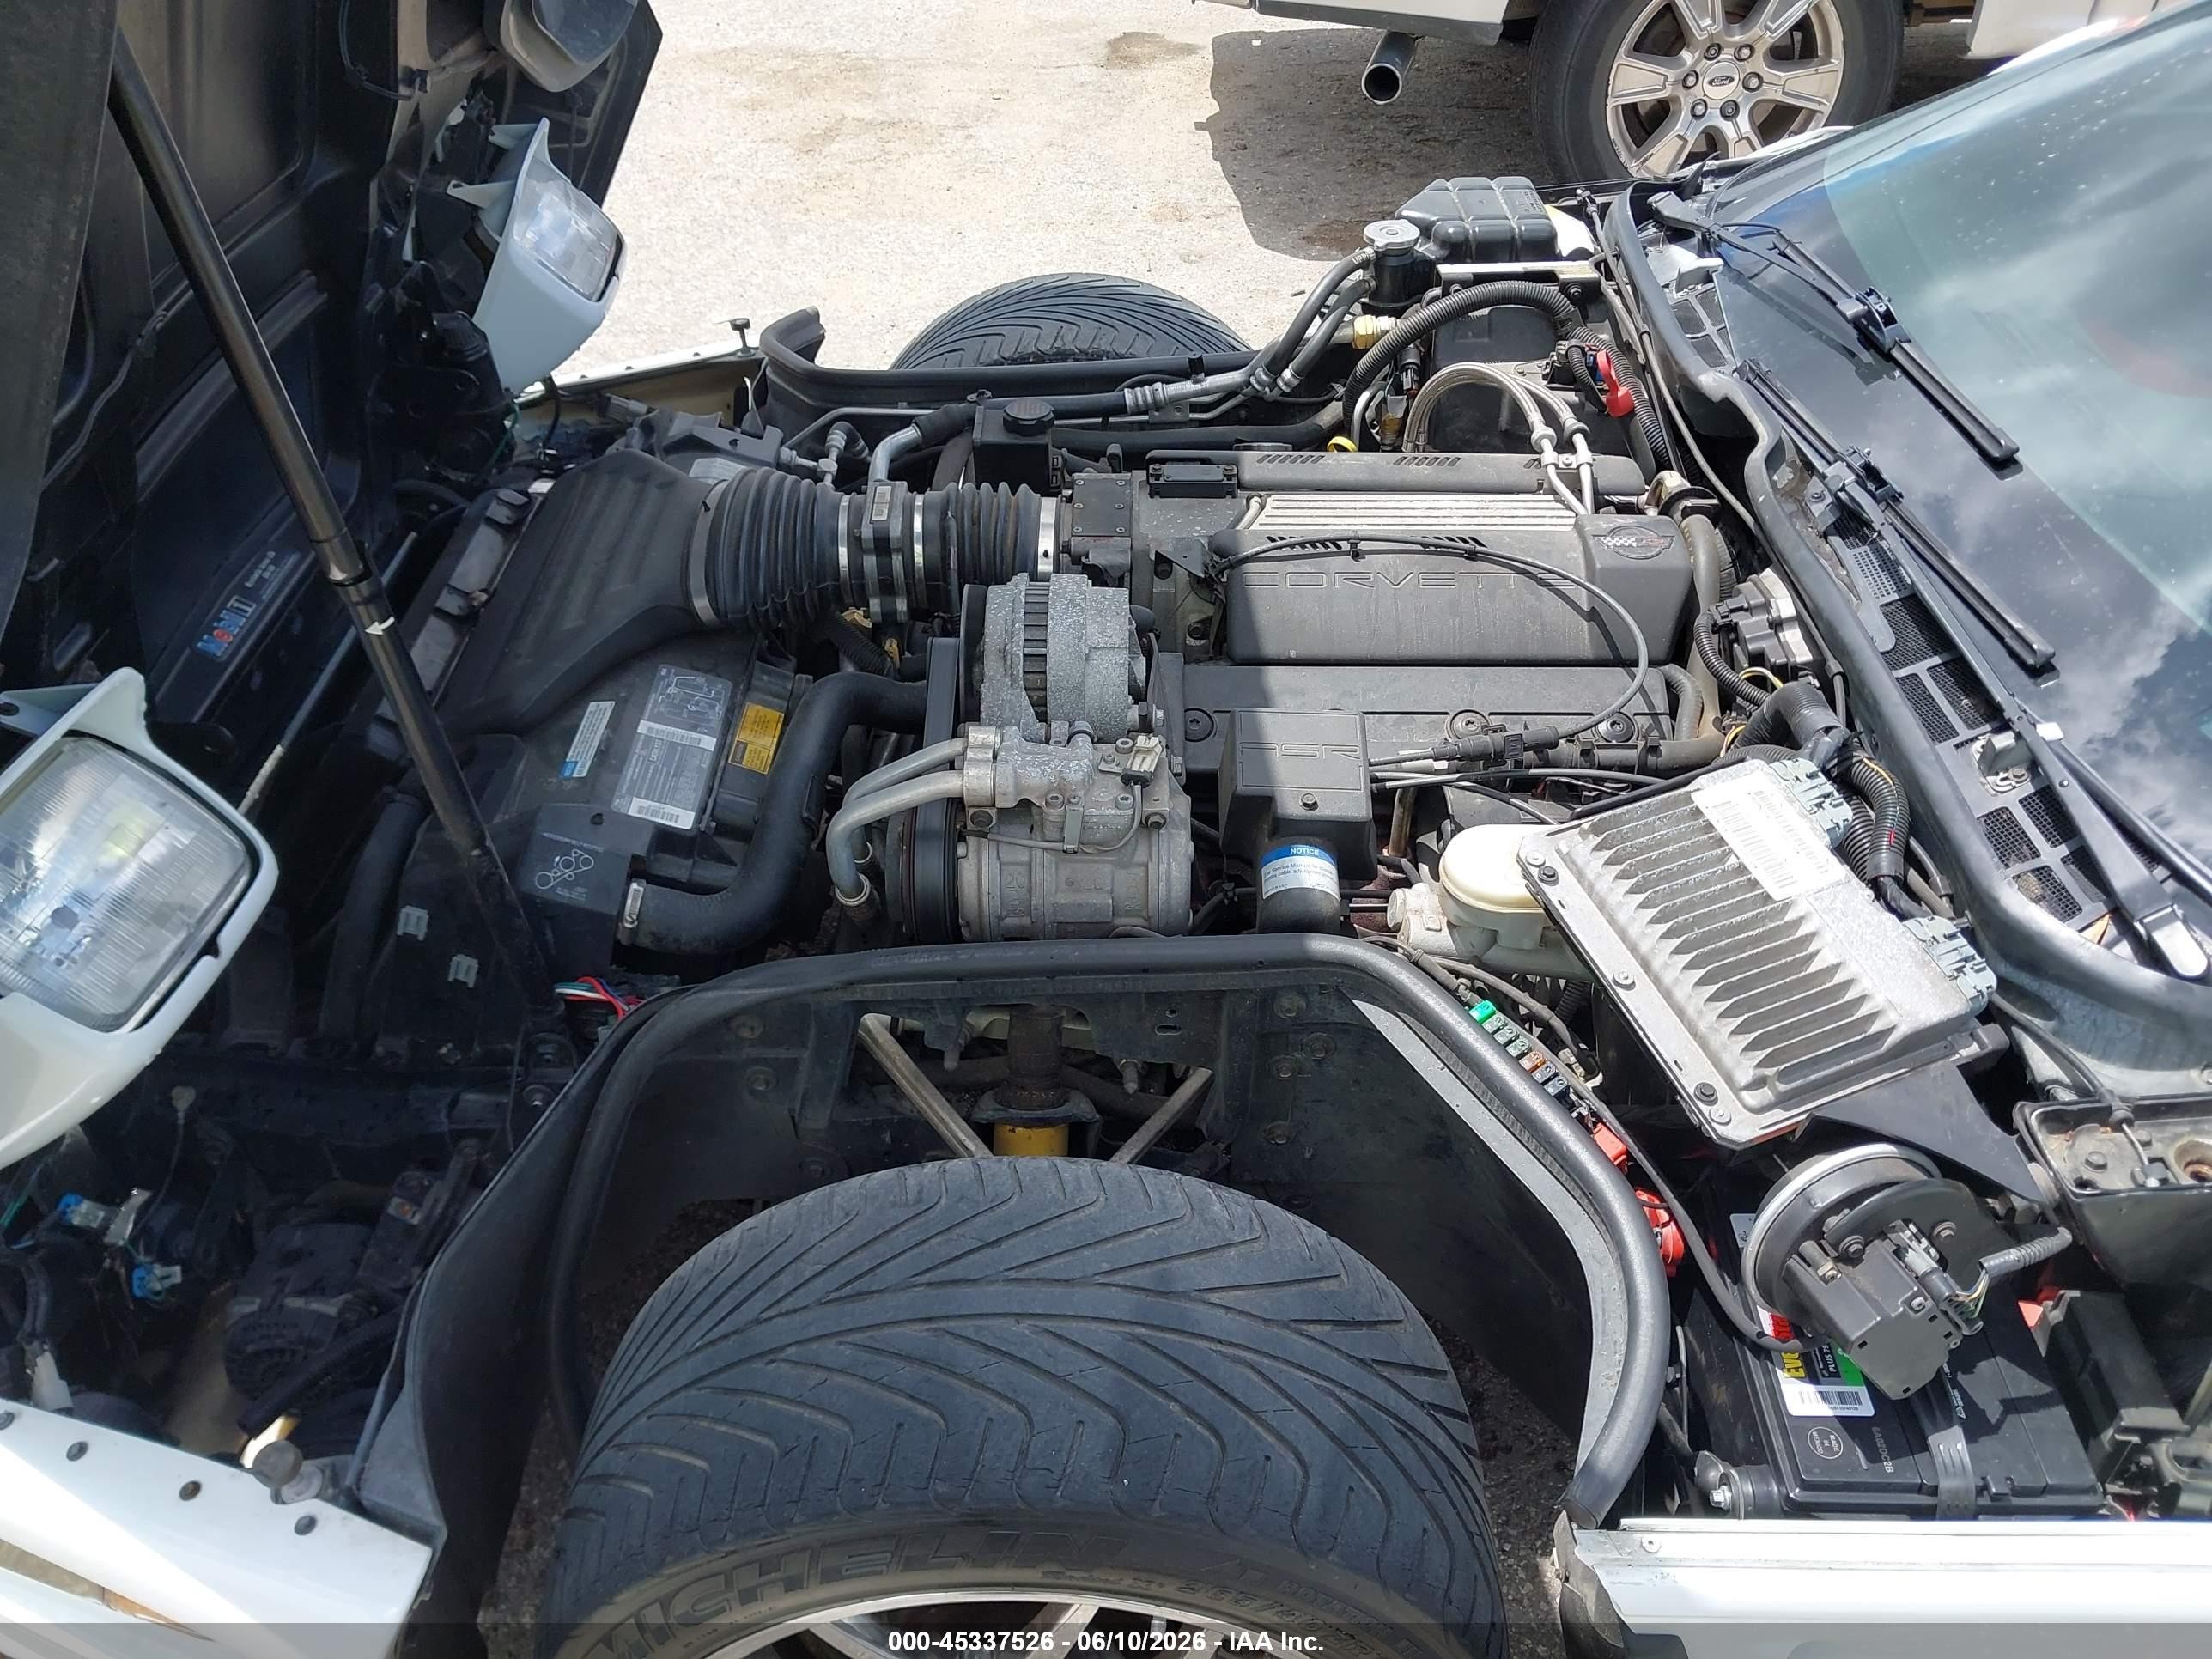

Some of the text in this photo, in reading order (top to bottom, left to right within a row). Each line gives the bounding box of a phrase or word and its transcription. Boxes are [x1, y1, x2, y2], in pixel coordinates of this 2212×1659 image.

[1711, 76, 1731, 86] Ford
[1242, 571, 1576, 589] CORVETTE
[1238, 742, 1361, 760] ASR
[1290, 848, 1320, 856] NOTICE
[1826, 1354, 1838, 1373] PLUS
[1812, 1431, 1824, 1455] MEXICO
[1829, 1434, 1840, 1452] MADE
[586, 1531, 1128, 1659] MICHELIN
